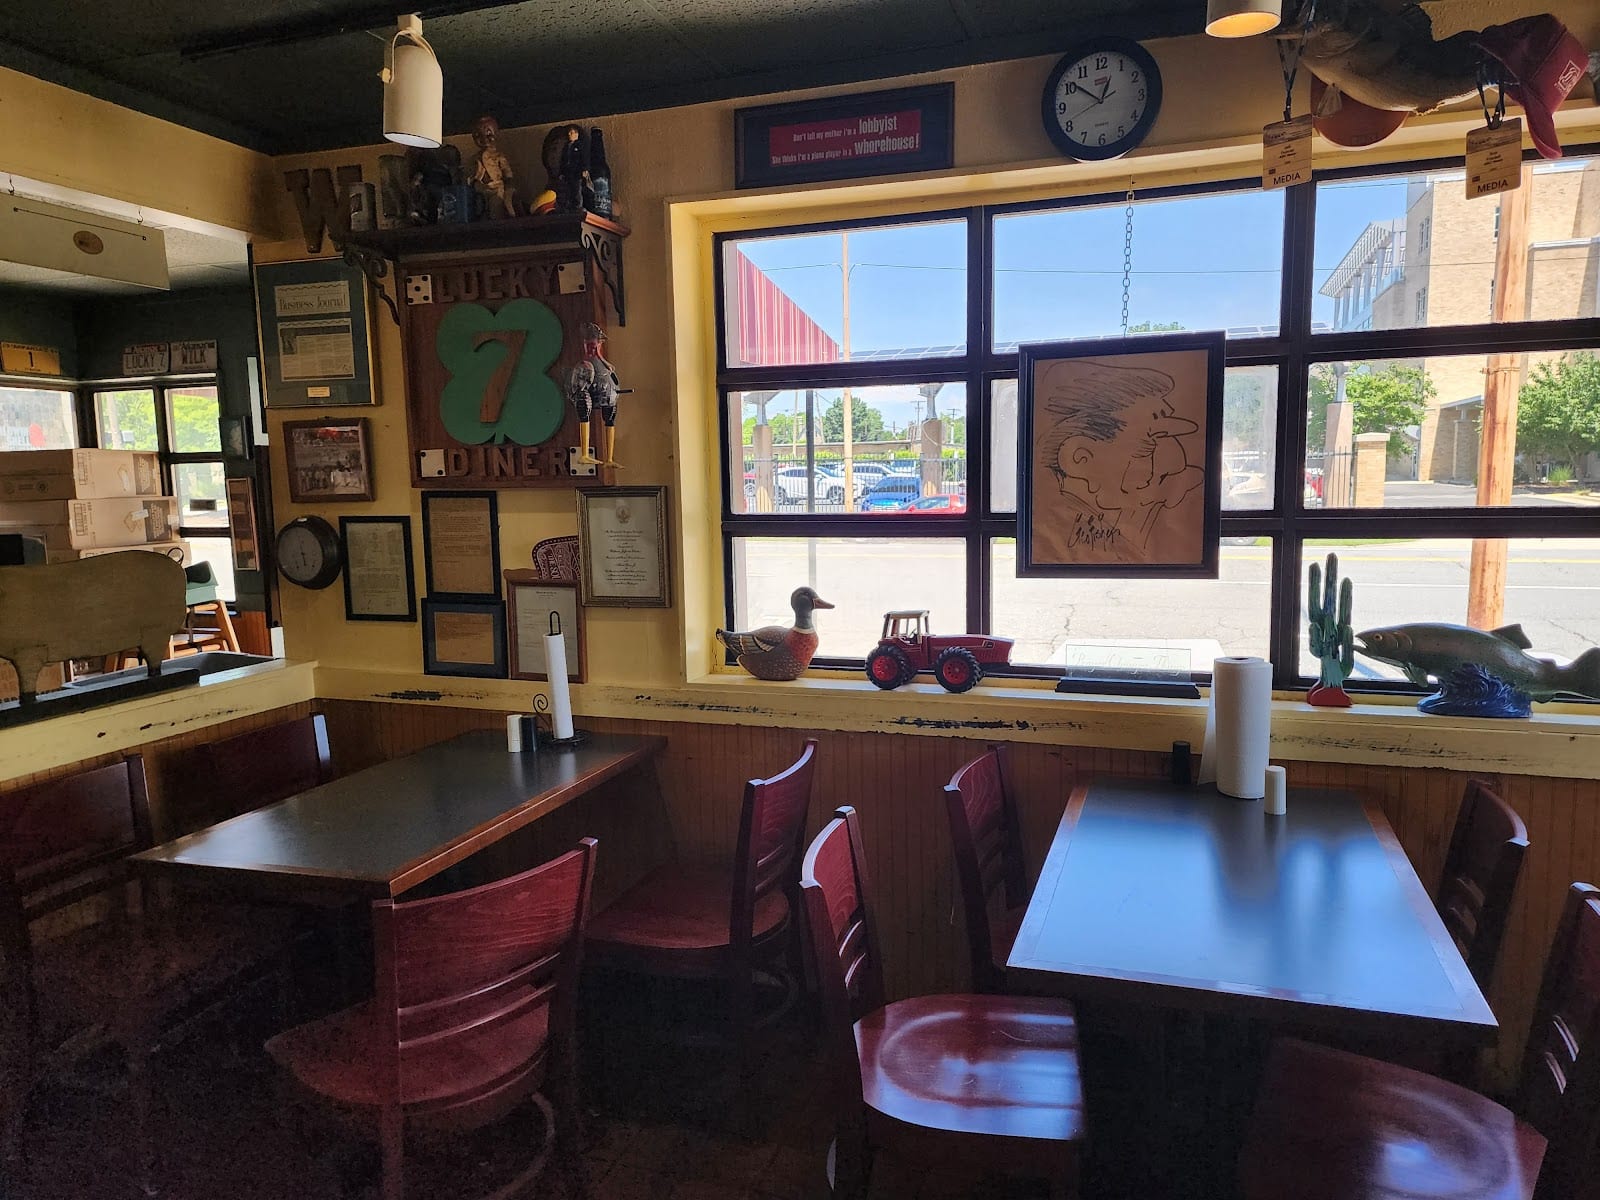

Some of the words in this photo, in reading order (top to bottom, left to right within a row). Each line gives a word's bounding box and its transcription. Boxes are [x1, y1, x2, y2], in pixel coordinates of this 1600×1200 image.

[1095, 57, 1108, 71] 12
[1119, 58, 1125, 72] 1
[1078, 65, 1088, 79] 11
[1131, 71, 1139, 83] 2
[1065, 82, 1077, 95] 10
[1137, 89, 1145, 101] 3
[1059, 102, 1066, 115] 9
[1130, 110, 1139, 121] 4
[859, 115, 898, 136] lobbyist
[1065, 120, 1073, 133] 8
[1117, 126, 1125, 138] 5
[854, 132, 920, 155] whorehouse!
[1080, 131, 1088, 144] 7
[1098, 134, 1106, 145] 6
[1273, 172, 1301, 185] MEDIA
[1477, 179, 1508, 193] MEDIA
[436, 262, 555, 302] LUCKY
[280, 297, 314, 311] Business
[317, 293, 347, 309] Journal
[28, 351, 34, 368] 1
[126, 352, 155, 369] LUCKY
[159, 352, 165, 368] 7
[472, 330, 529, 424] 7
[447, 446, 569, 477] DINER
